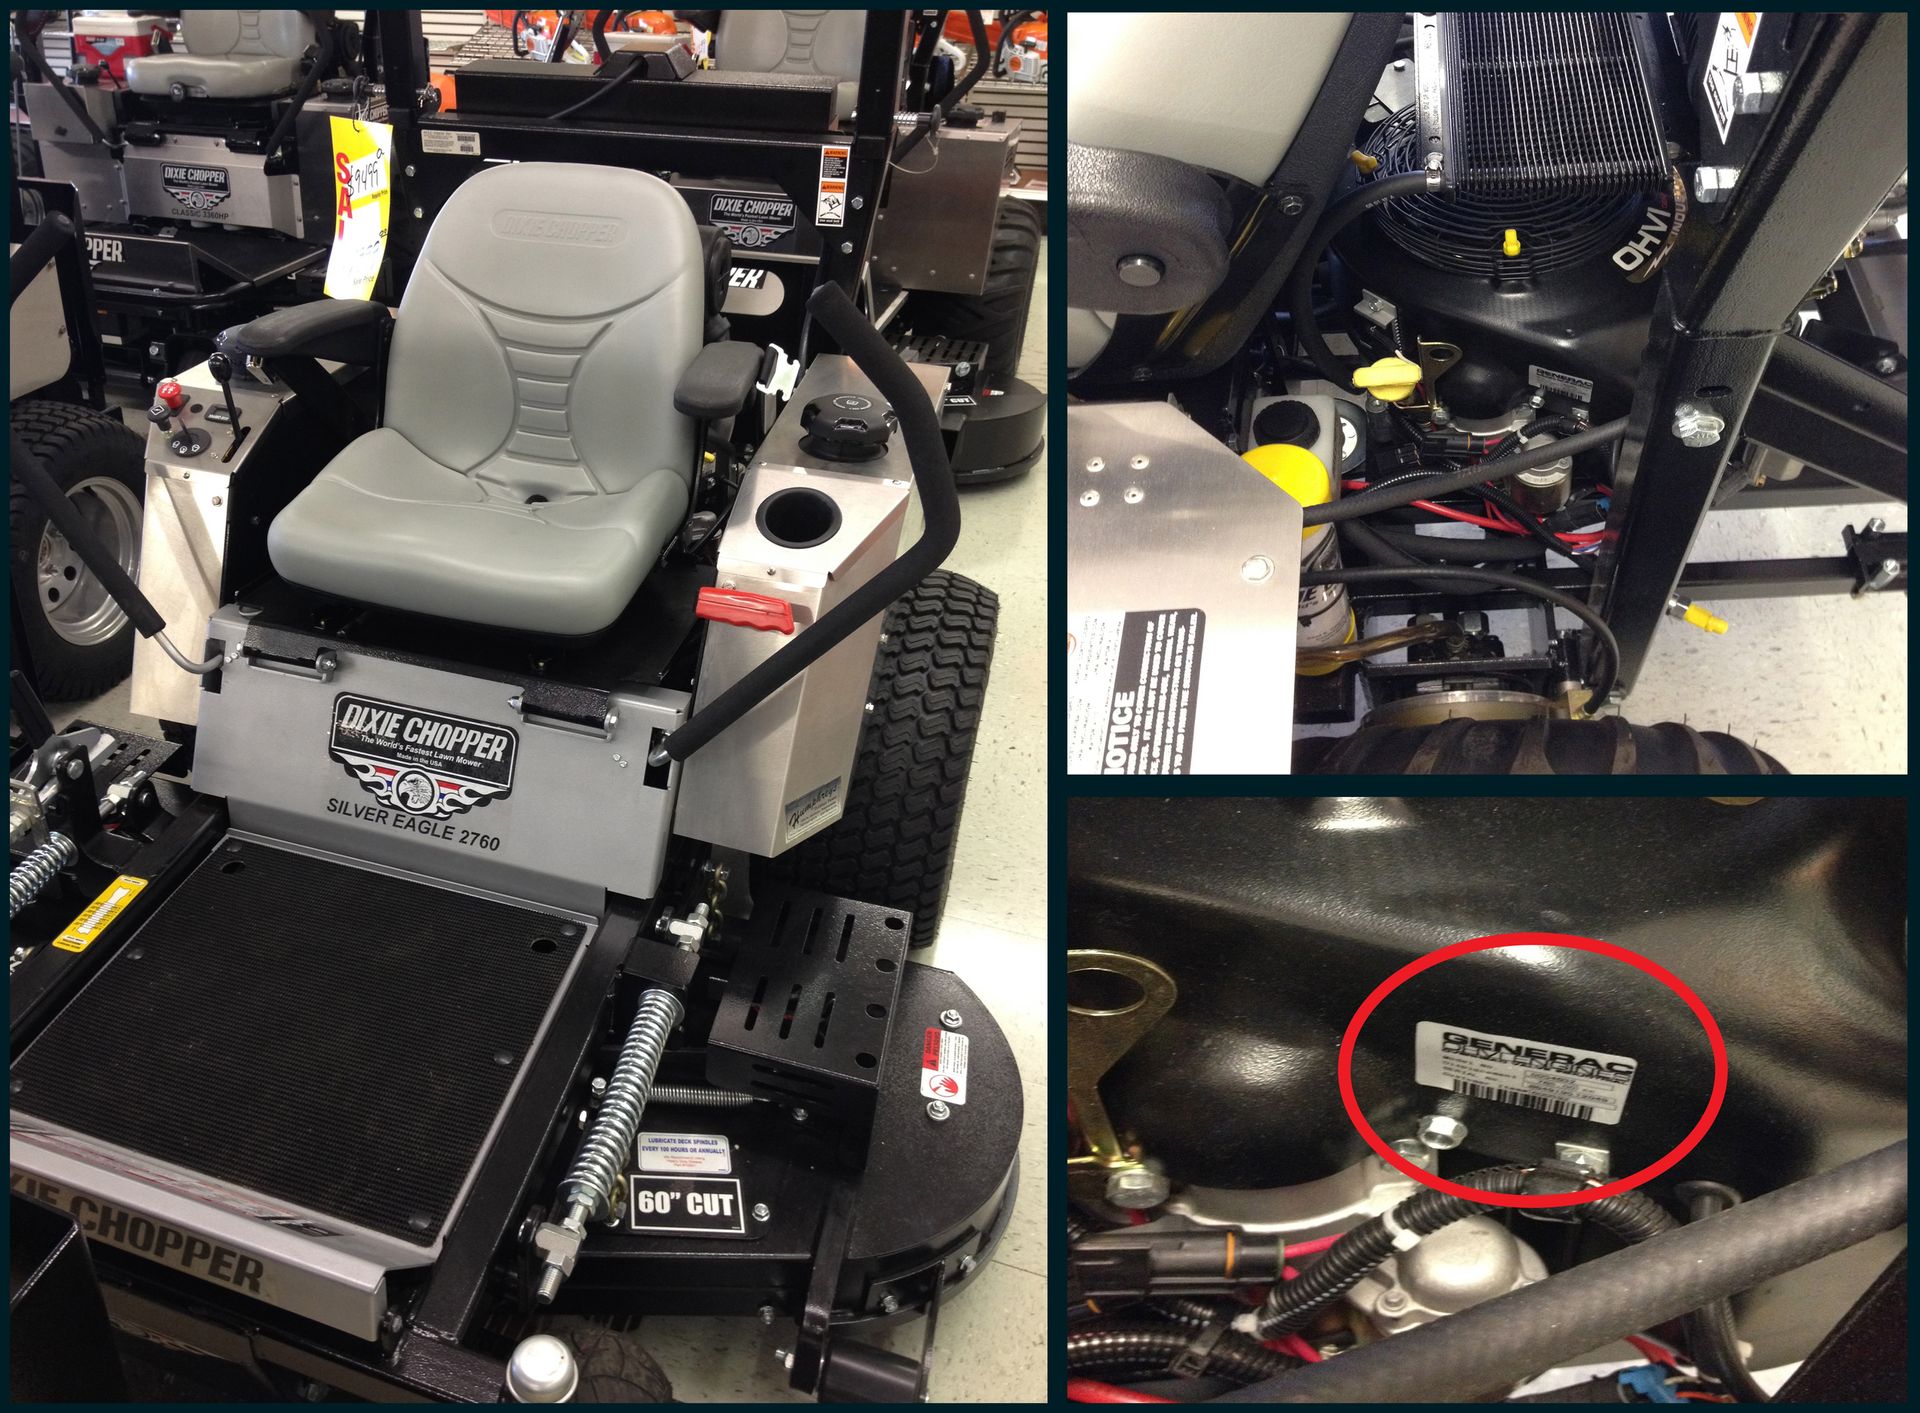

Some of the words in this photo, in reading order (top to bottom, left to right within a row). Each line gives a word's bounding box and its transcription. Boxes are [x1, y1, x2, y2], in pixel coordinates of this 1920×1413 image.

[164, 166, 187, 180] DIXIE
[187, 168, 225, 183] CHOPPER
[171, 208, 202, 218] CLASSIC
[713, 197, 744, 213] DIXIE
[743, 200, 793, 217] CHOPPER
[1612, 206, 1671, 271] OHVI
[1154, 641, 1162, 652] TO
[1133, 714, 1141, 727] TO
[341, 703, 404, 739] DIXIE
[402, 717, 508, 762] CHOPPER
[361, 734, 375, 744] The
[376, 737, 404, 750] World's
[405, 743, 433, 758] Fastest
[433, 750, 455, 762] Lawn
[396, 752, 412, 761] Made
[429, 759, 443, 767] USA
[1173, 753, 1182, 767] TO
[327, 798, 389, 825] SILVER
[392, 813, 455, 841] EAGLE
[458, 829, 500, 851] 2760
[1442, 1031, 1635, 1076] GENERAC
[638, 1190, 681, 1214] 60"
[686, 1192, 734, 1216] CUT
[69, 1195, 264, 1294] CHOPPER
